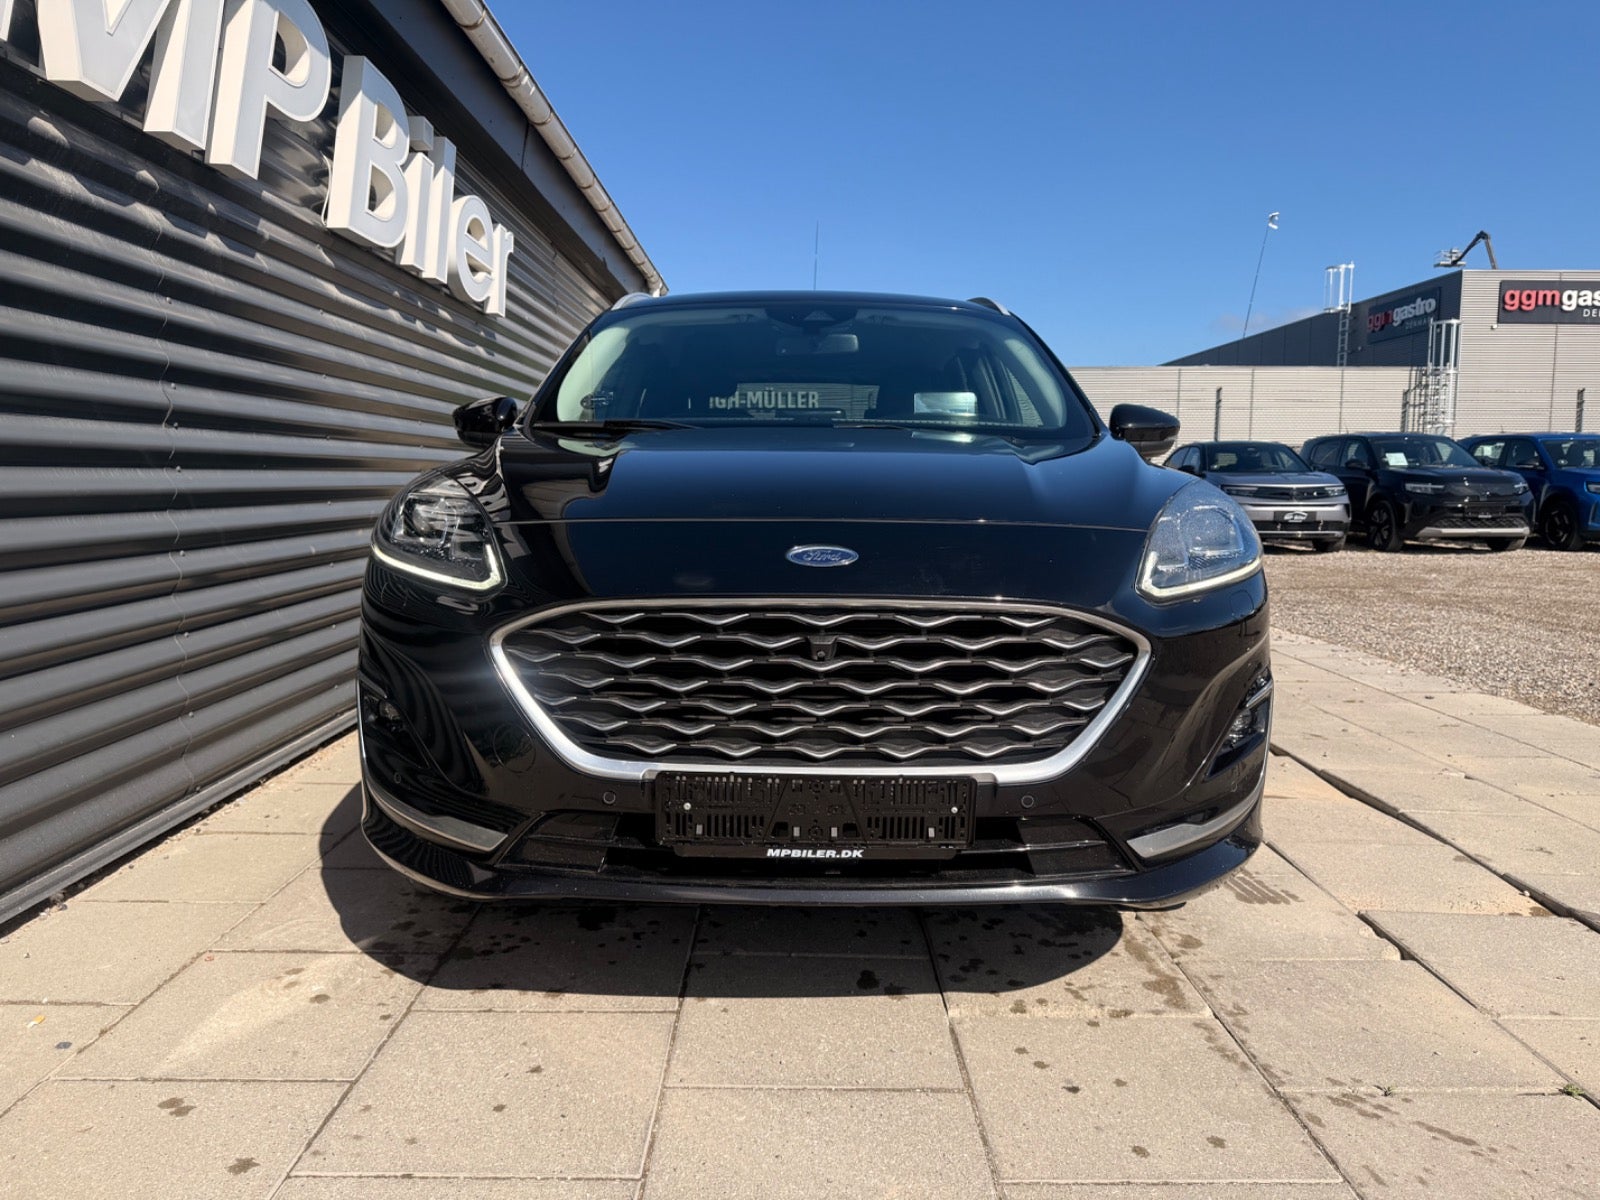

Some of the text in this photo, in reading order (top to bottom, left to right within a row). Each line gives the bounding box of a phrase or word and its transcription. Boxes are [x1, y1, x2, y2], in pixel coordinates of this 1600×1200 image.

[327, 55, 514, 318] Biler
[1583, 308, 1600, 317] DE
[803, 549, 841, 561] Ford
[767, 848, 864, 858] MPBILER.DK
